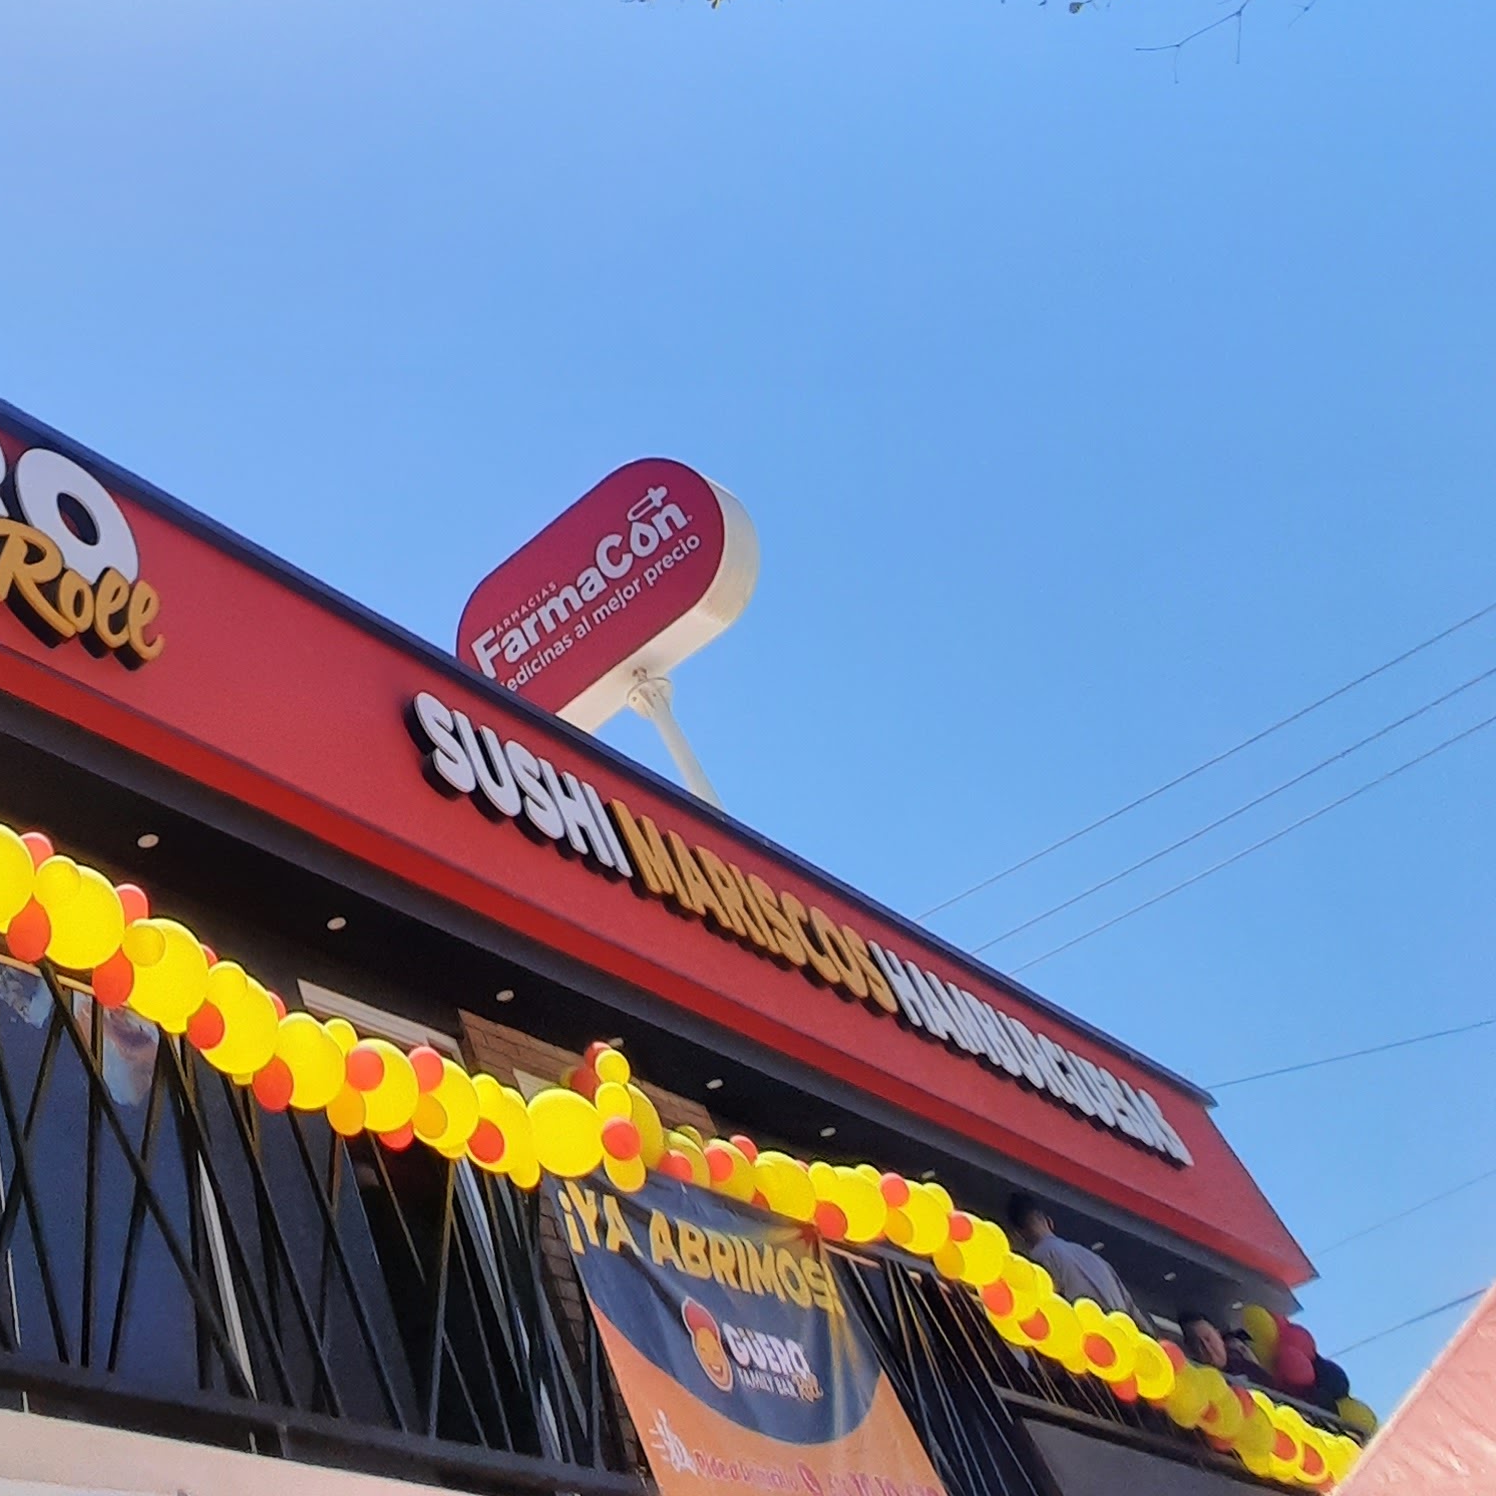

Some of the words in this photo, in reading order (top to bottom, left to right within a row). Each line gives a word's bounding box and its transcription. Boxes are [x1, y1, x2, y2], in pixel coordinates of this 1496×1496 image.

[500, 633, 574, 692] edicinas
[573, 615, 592, 639] al
[591, 577, 642, 625] mejor
[643, 534, 701, 587] precio
[412, 690, 634, 878] SUSHI
[608, 797, 899, 1014] MARISCOS
[867, 939, 1195, 1167] HAMBURGUESAS
[557, 1179, 644, 1259] ¡YA
[721, 1321, 812, 1381] GÜERO
